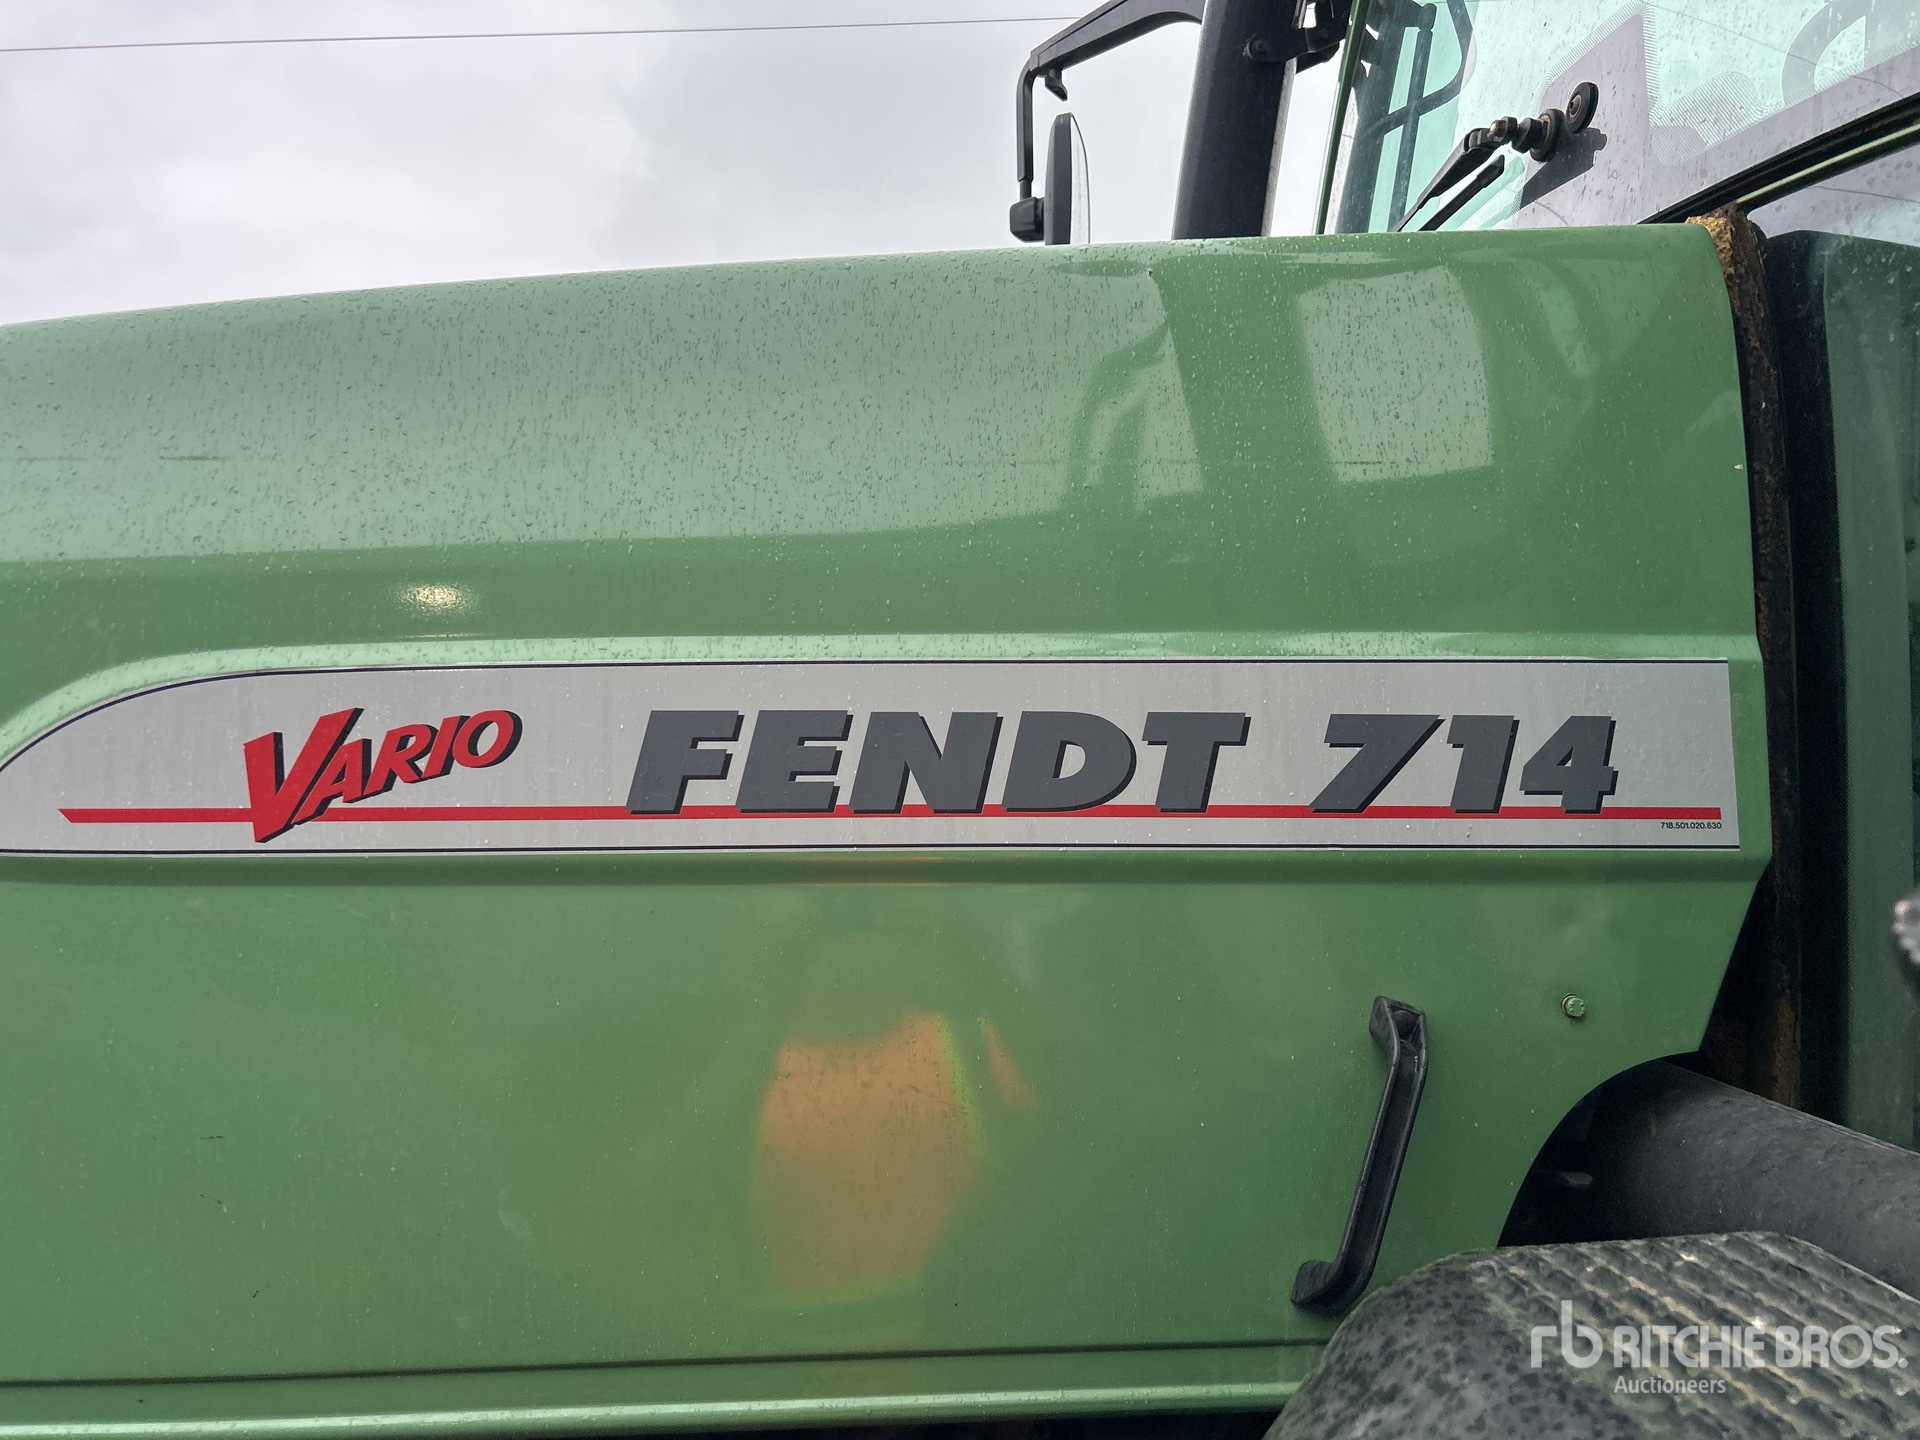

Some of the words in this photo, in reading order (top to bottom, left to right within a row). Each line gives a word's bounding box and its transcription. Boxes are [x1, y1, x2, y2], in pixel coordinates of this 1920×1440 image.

[244, 707, 523, 843] VARIO
[626, 710, 1251, 815] FENDT
[1308, 713, 1619, 814] 714
